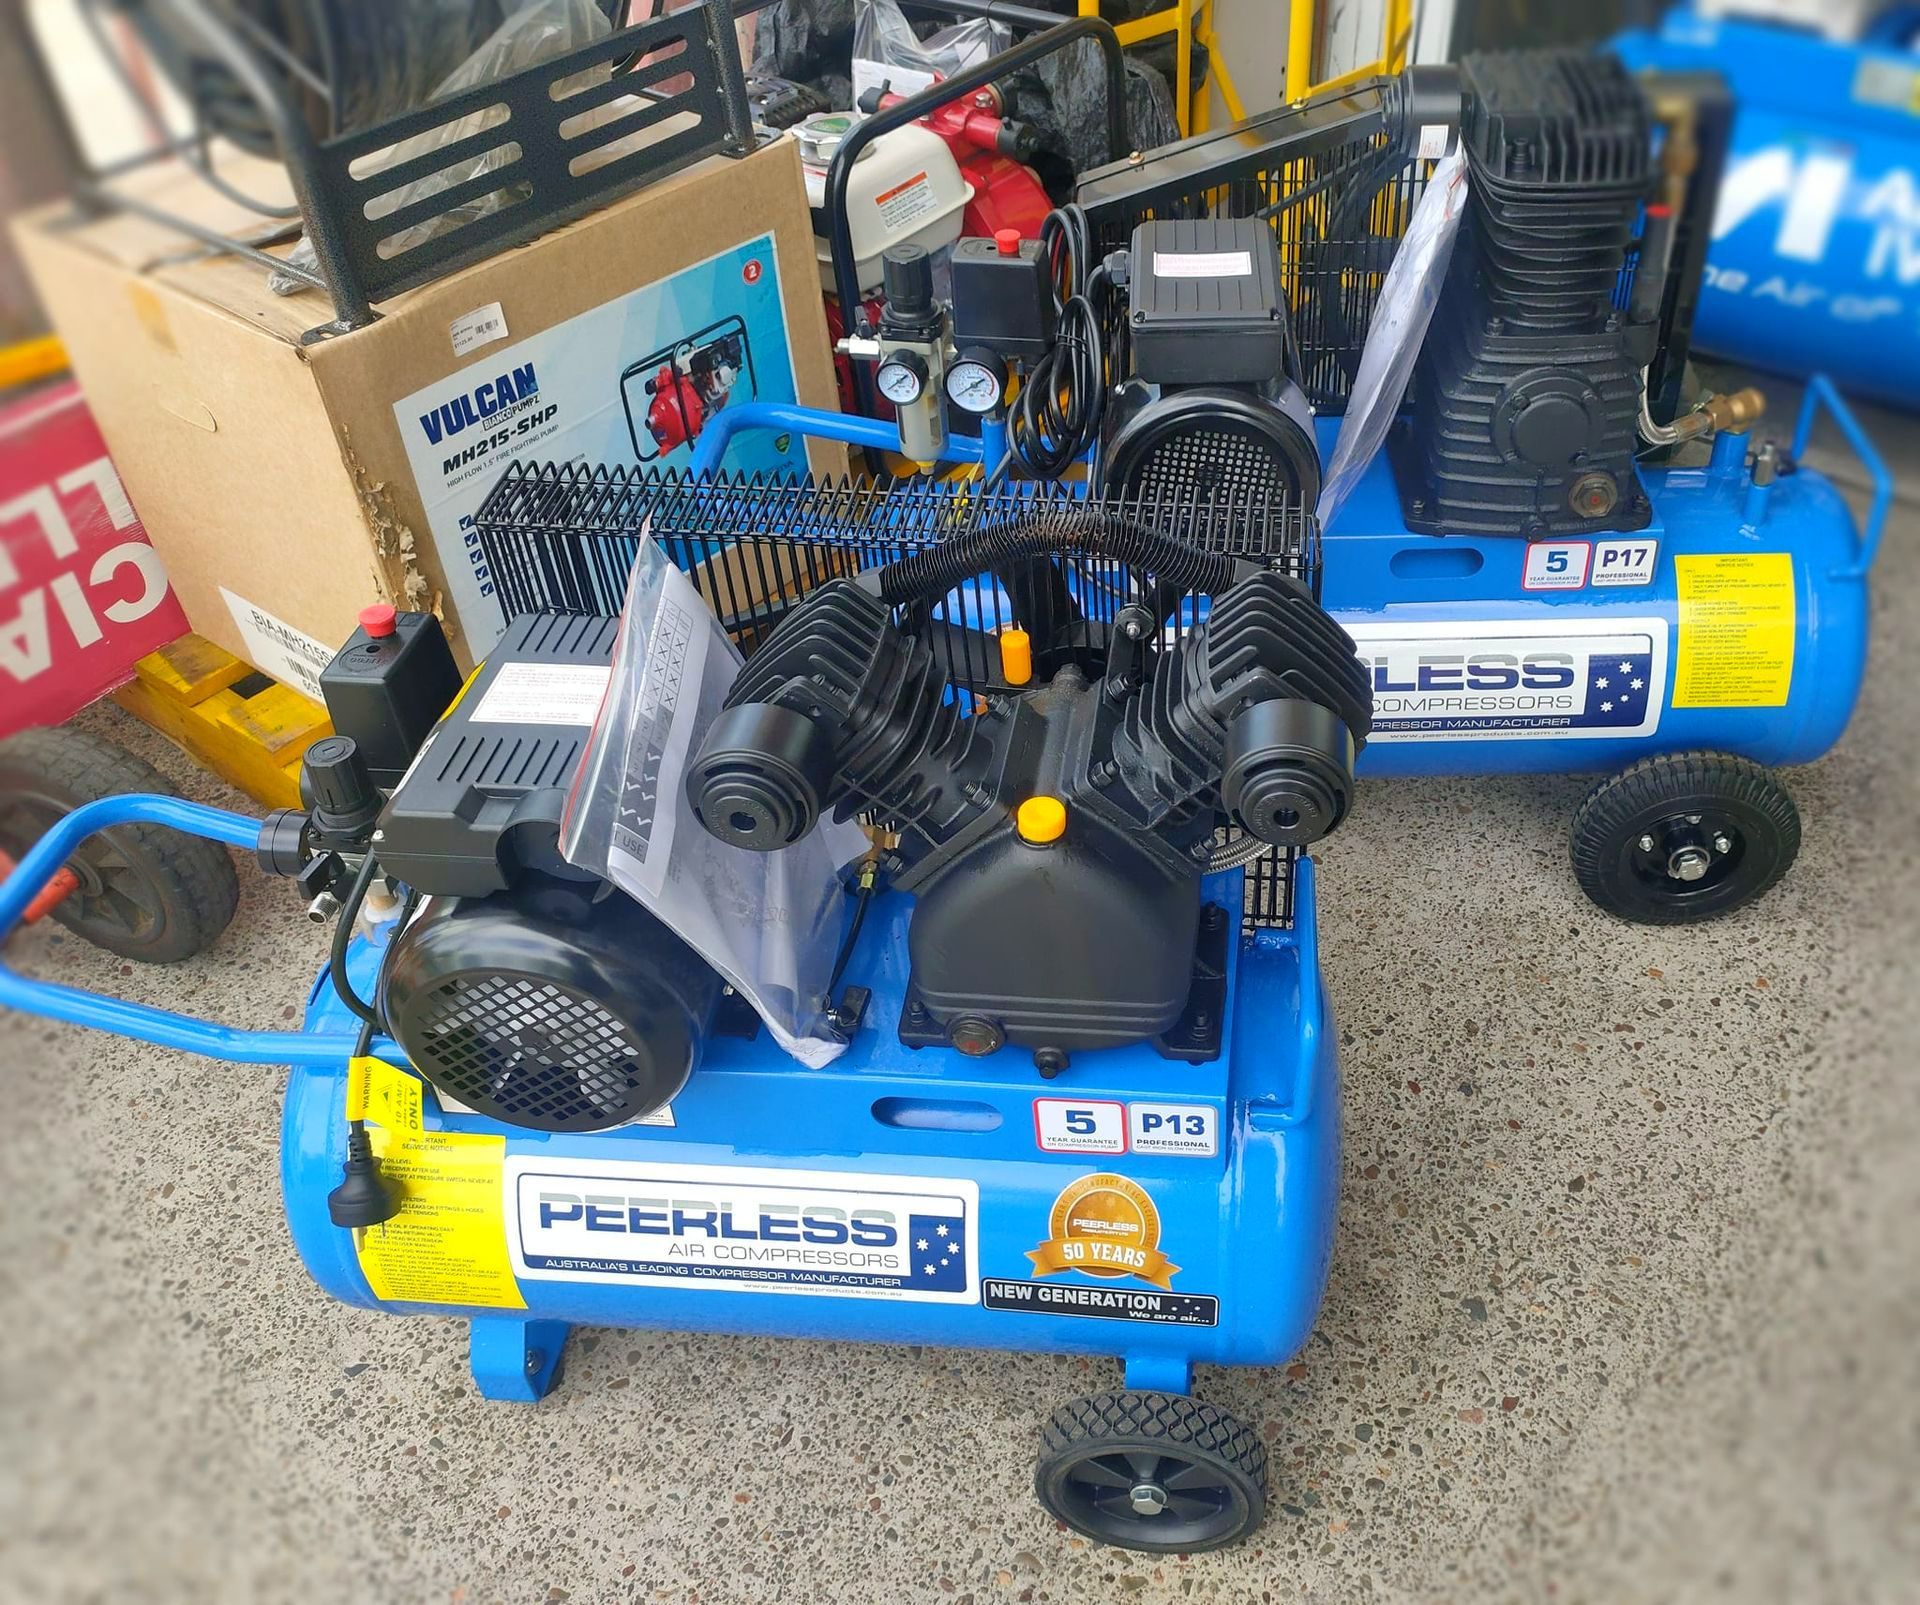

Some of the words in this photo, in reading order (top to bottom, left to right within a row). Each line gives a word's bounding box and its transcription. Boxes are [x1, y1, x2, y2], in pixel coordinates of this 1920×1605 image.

[749, 264, 758, 279] 2
[419, 362, 540, 446] VULCAN
[482, 407, 513, 431] BIANCO
[512, 395, 540, 416] PUMPZ
[443, 404, 558, 475] MH215-SHP
[447, 475, 466, 488] HIGH
[464, 464, 484, 481] FLOW
[496, 449, 511, 462] FIRE
[511, 434, 540, 455] FIGHTING
[540, 424, 560, 438] PUMP
[1546, 551, 1568, 572] 5
[1602, 549, 1648, 568] P17
[1357, 653, 1575, 692] LESS
[1390, 730, 1568, 740] www.peerlessproducts.com.au
[1447, 718, 1571, 728] MANUFACTURER
[622, 835, 644, 856] USE
[362, 1066, 372, 1110] WARNING
[409, 1088, 418, 1130] ONLY
[1066, 1110, 1096, 1134] 5
[1142, 1114, 1205, 1136] P13
[1136, 1139, 1210, 1148] PROFESSIONAL
[540, 1192, 898, 1248] PEERLESS
[1073, 1218, 1138, 1232] PEERLESS
[668, 1242, 706, 1258] AIR
[714, 1244, 900, 1269] COMPRESSORS
[1063, 1242, 1085, 1260] 50
[1090, 1242, 1146, 1268] YEARS
[545, 1258, 628, 1272] AUSTRALIA'S
[632, 1263, 688, 1276] LEADING
[693, 1266, 787, 1281] COMPRESSOR
[790, 1272, 902, 1288] MANUFACTURER
[743, 1281, 903, 1298] www.peerlessproducts.com.au
[990, 1283, 1033, 1300] NEW
[1038, 1288, 1161, 1311] GENERATION
[1128, 1310, 1150, 1318] We
[1180, 1312, 1210, 1323] air...
